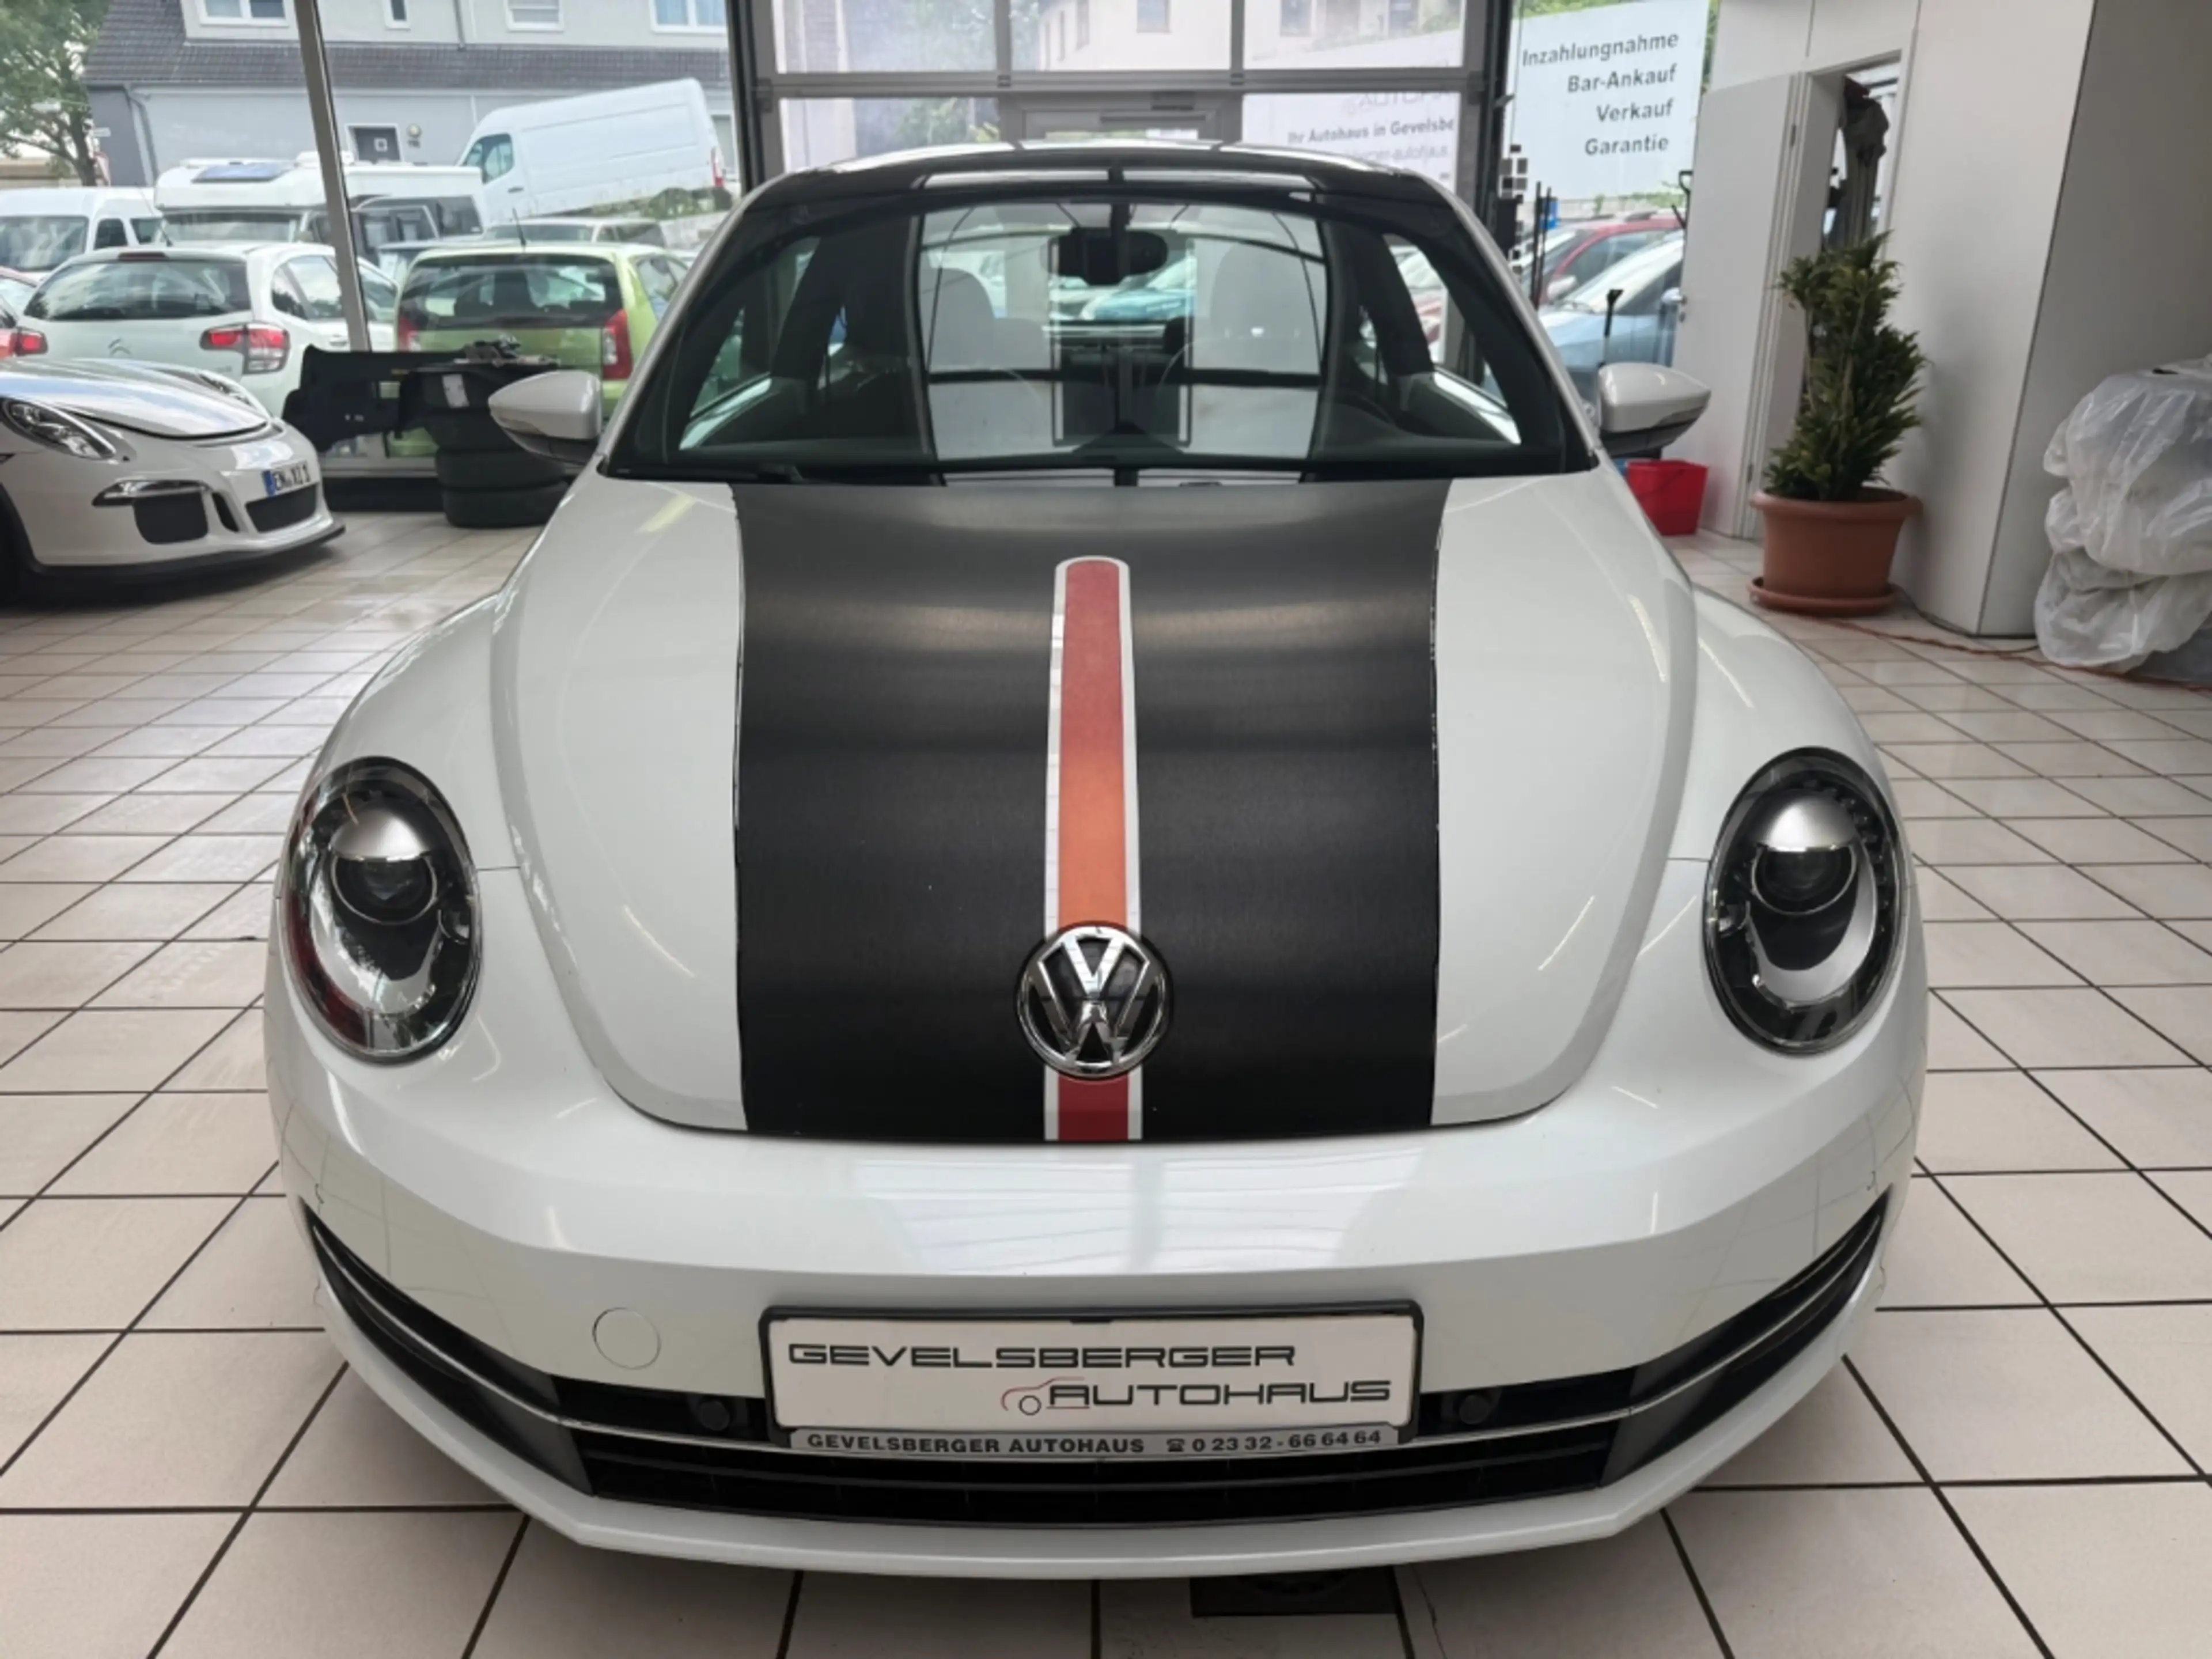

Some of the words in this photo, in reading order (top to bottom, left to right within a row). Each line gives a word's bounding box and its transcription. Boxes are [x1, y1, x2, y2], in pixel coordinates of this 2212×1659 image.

[1522, 33, 1679, 67] Inzahlungnahme
[1567, 63, 1677, 93] Bar-Ankauf
[1596, 98, 1674, 123] Verkauf
[1308, 126, 1370, 142] Autohaus
[1373, 122, 1386, 137] in
[1584, 134, 1669, 156] Garantie
[788, 1343, 1296, 1369] GEVELSBERGER
[1049, 1380, 1392, 1406] AUTOHAUS
[808, 1433, 1001, 1453] GEVELSBERGER
[1008, 1438, 1145, 1453] AUTOHAUS
